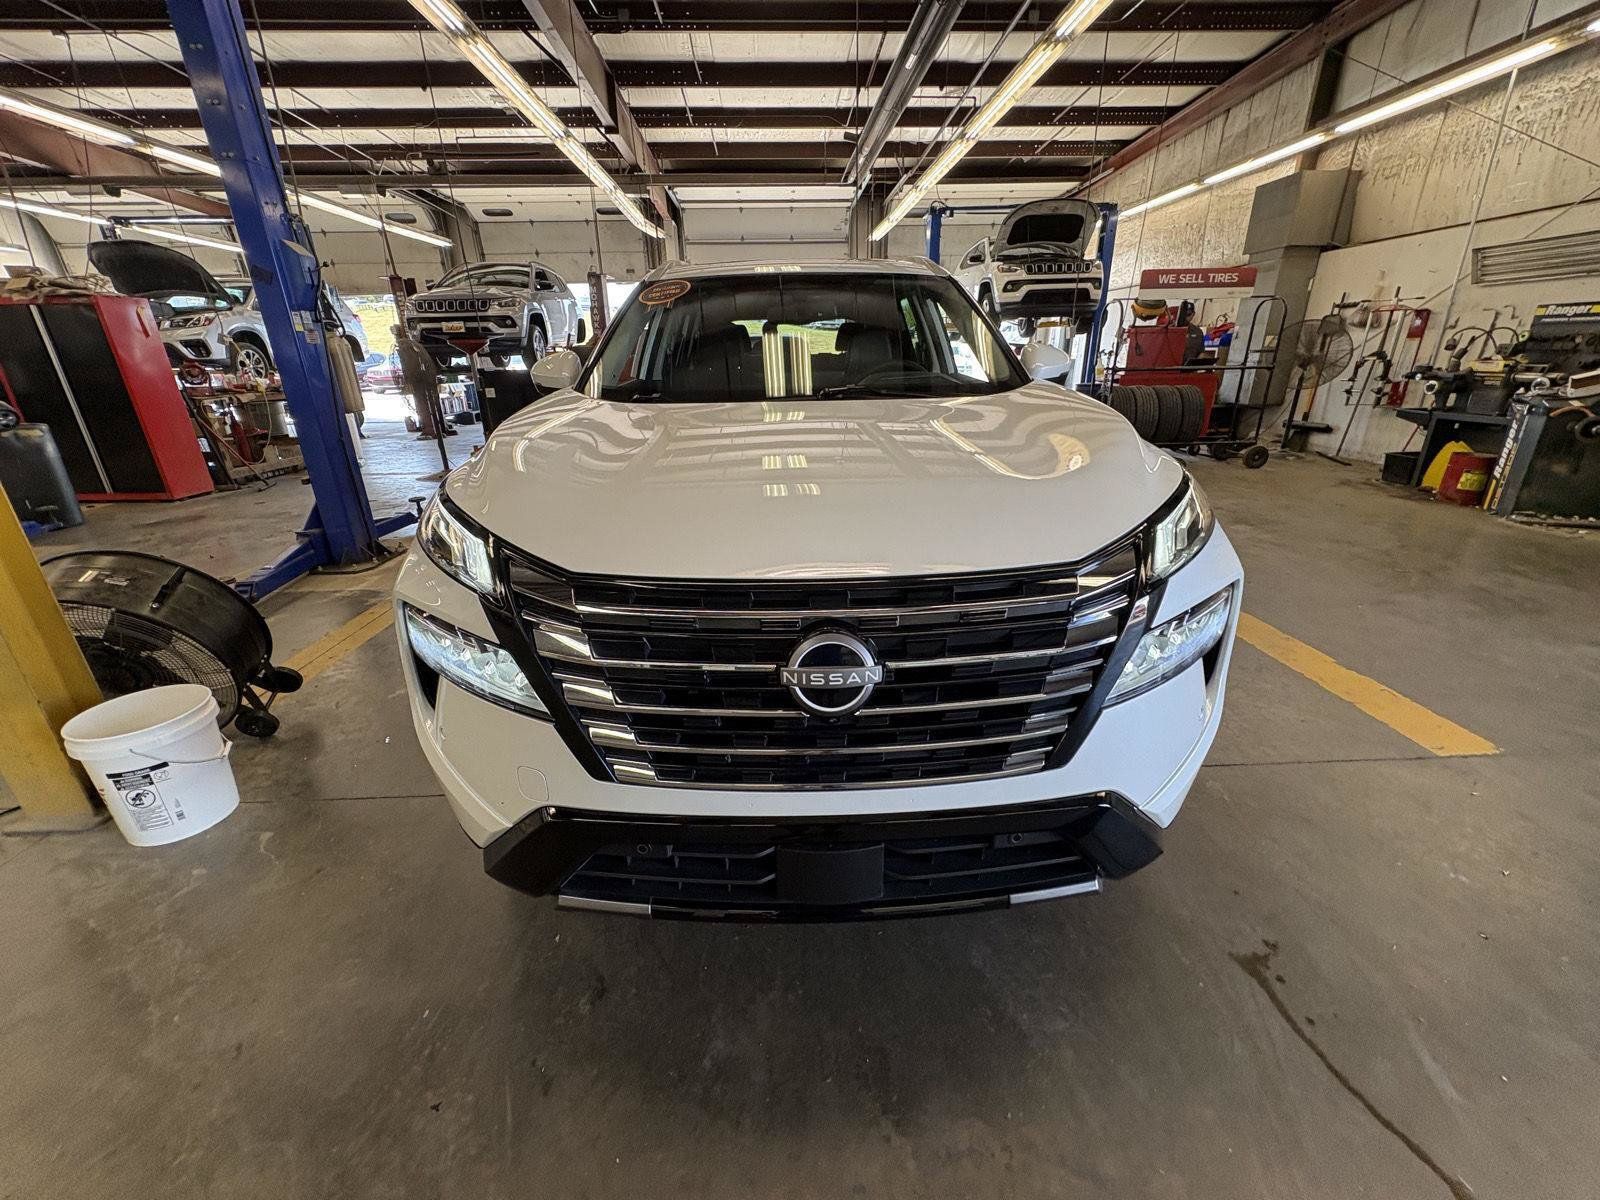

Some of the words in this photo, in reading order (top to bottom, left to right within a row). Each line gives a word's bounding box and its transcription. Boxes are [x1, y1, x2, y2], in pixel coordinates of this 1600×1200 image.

[1159, 274, 1177, 284] WE
[1179, 273, 1205, 284] SELL
[1208, 272, 1239, 283] TIRES
[1544, 304, 1592, 316] Ranger
[1493, 418, 1519, 479] Ranger
[783, 670, 879, 685] NISSAN
